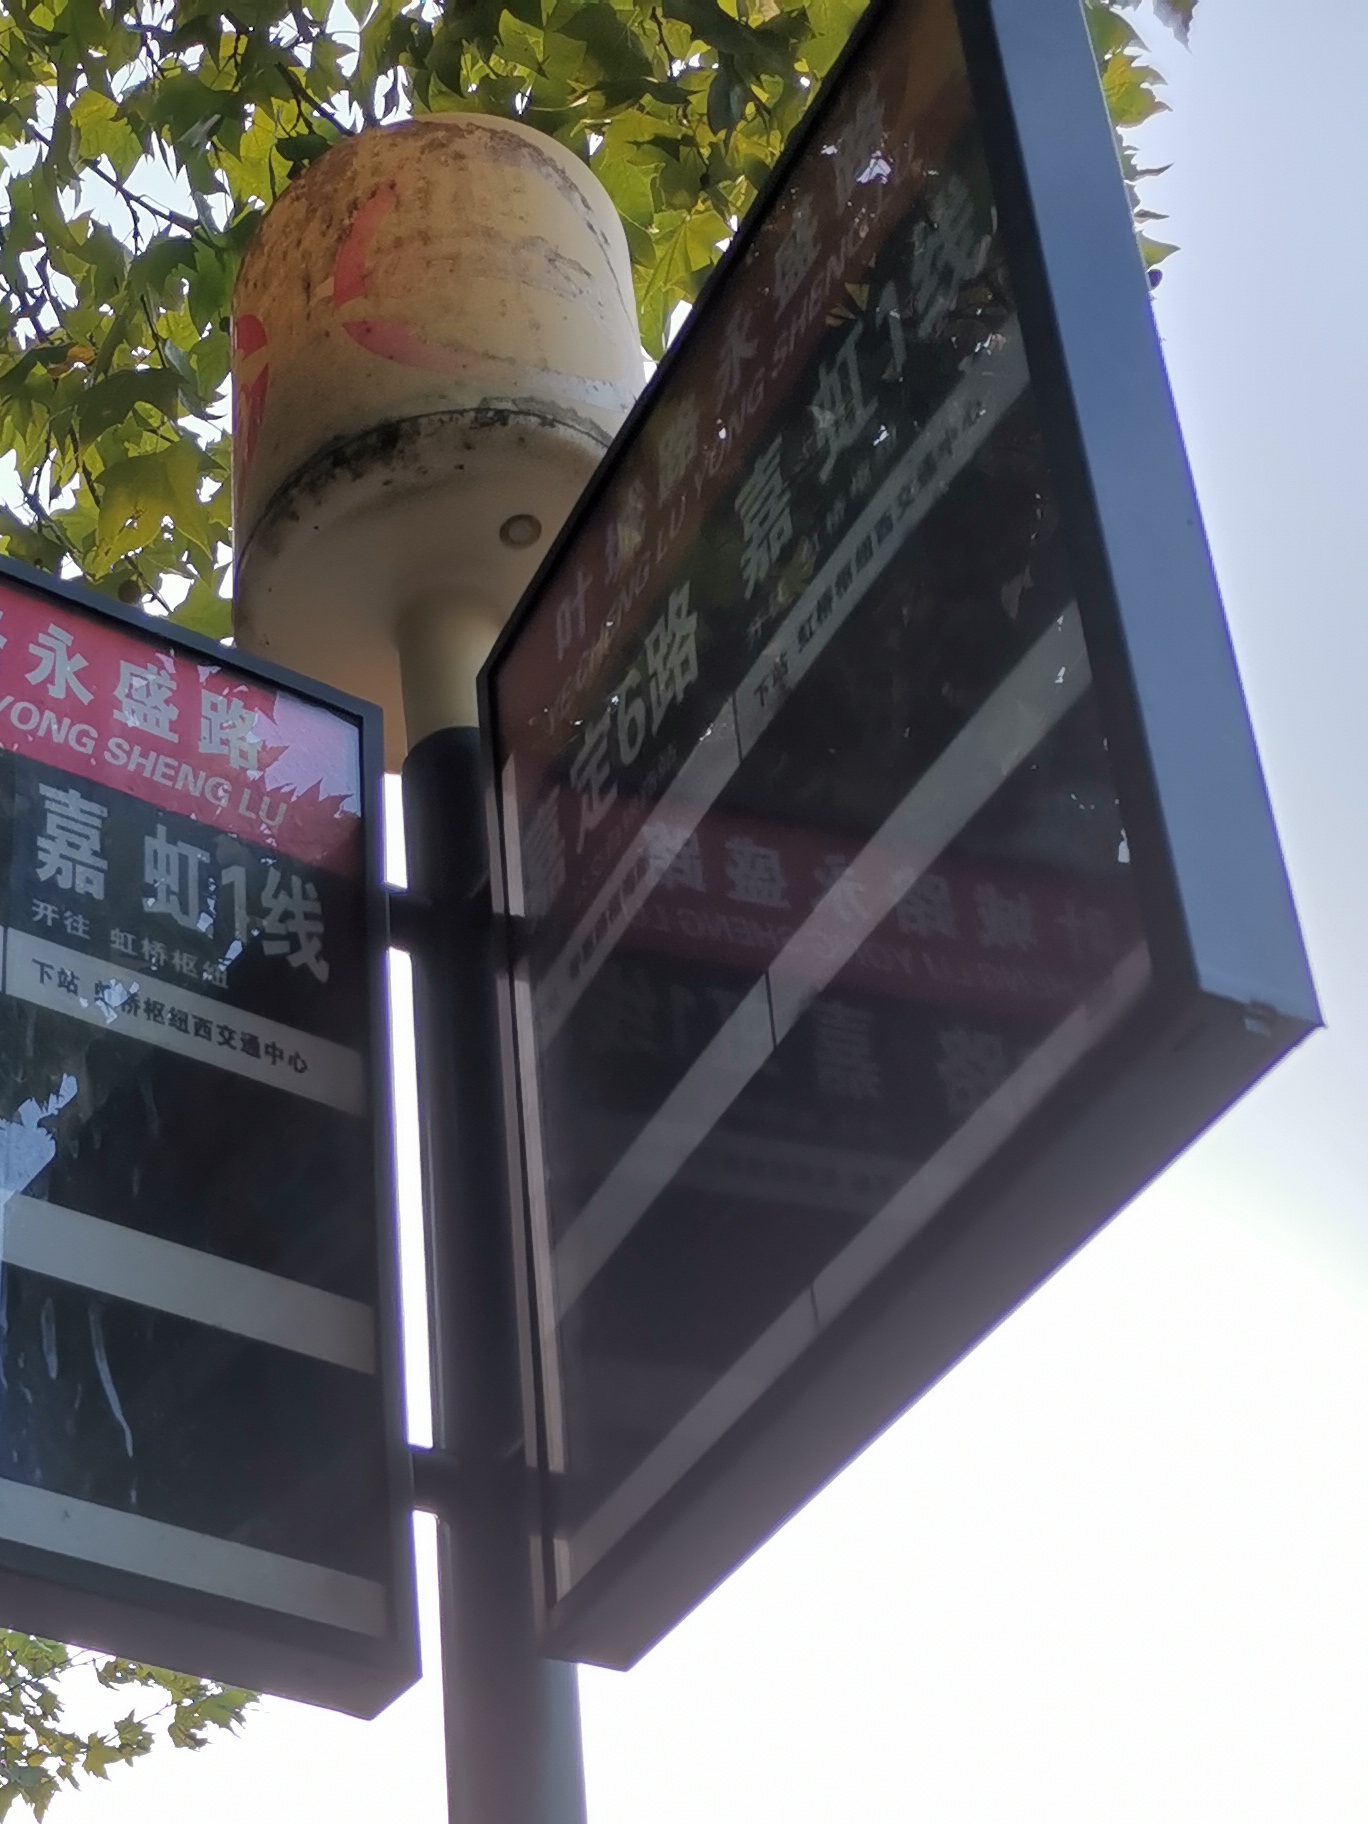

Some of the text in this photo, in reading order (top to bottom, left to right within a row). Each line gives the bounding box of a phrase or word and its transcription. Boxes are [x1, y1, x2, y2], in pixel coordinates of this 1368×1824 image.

[103, 737, 232, 811] SHENG
[236, 785, 289, 831] LU
[35, 778, 330, 984] 嘉虹1线
[32, 898, 230, 989] 开往 虹桥枢纽
[32, 957, 80, 995] 下站
